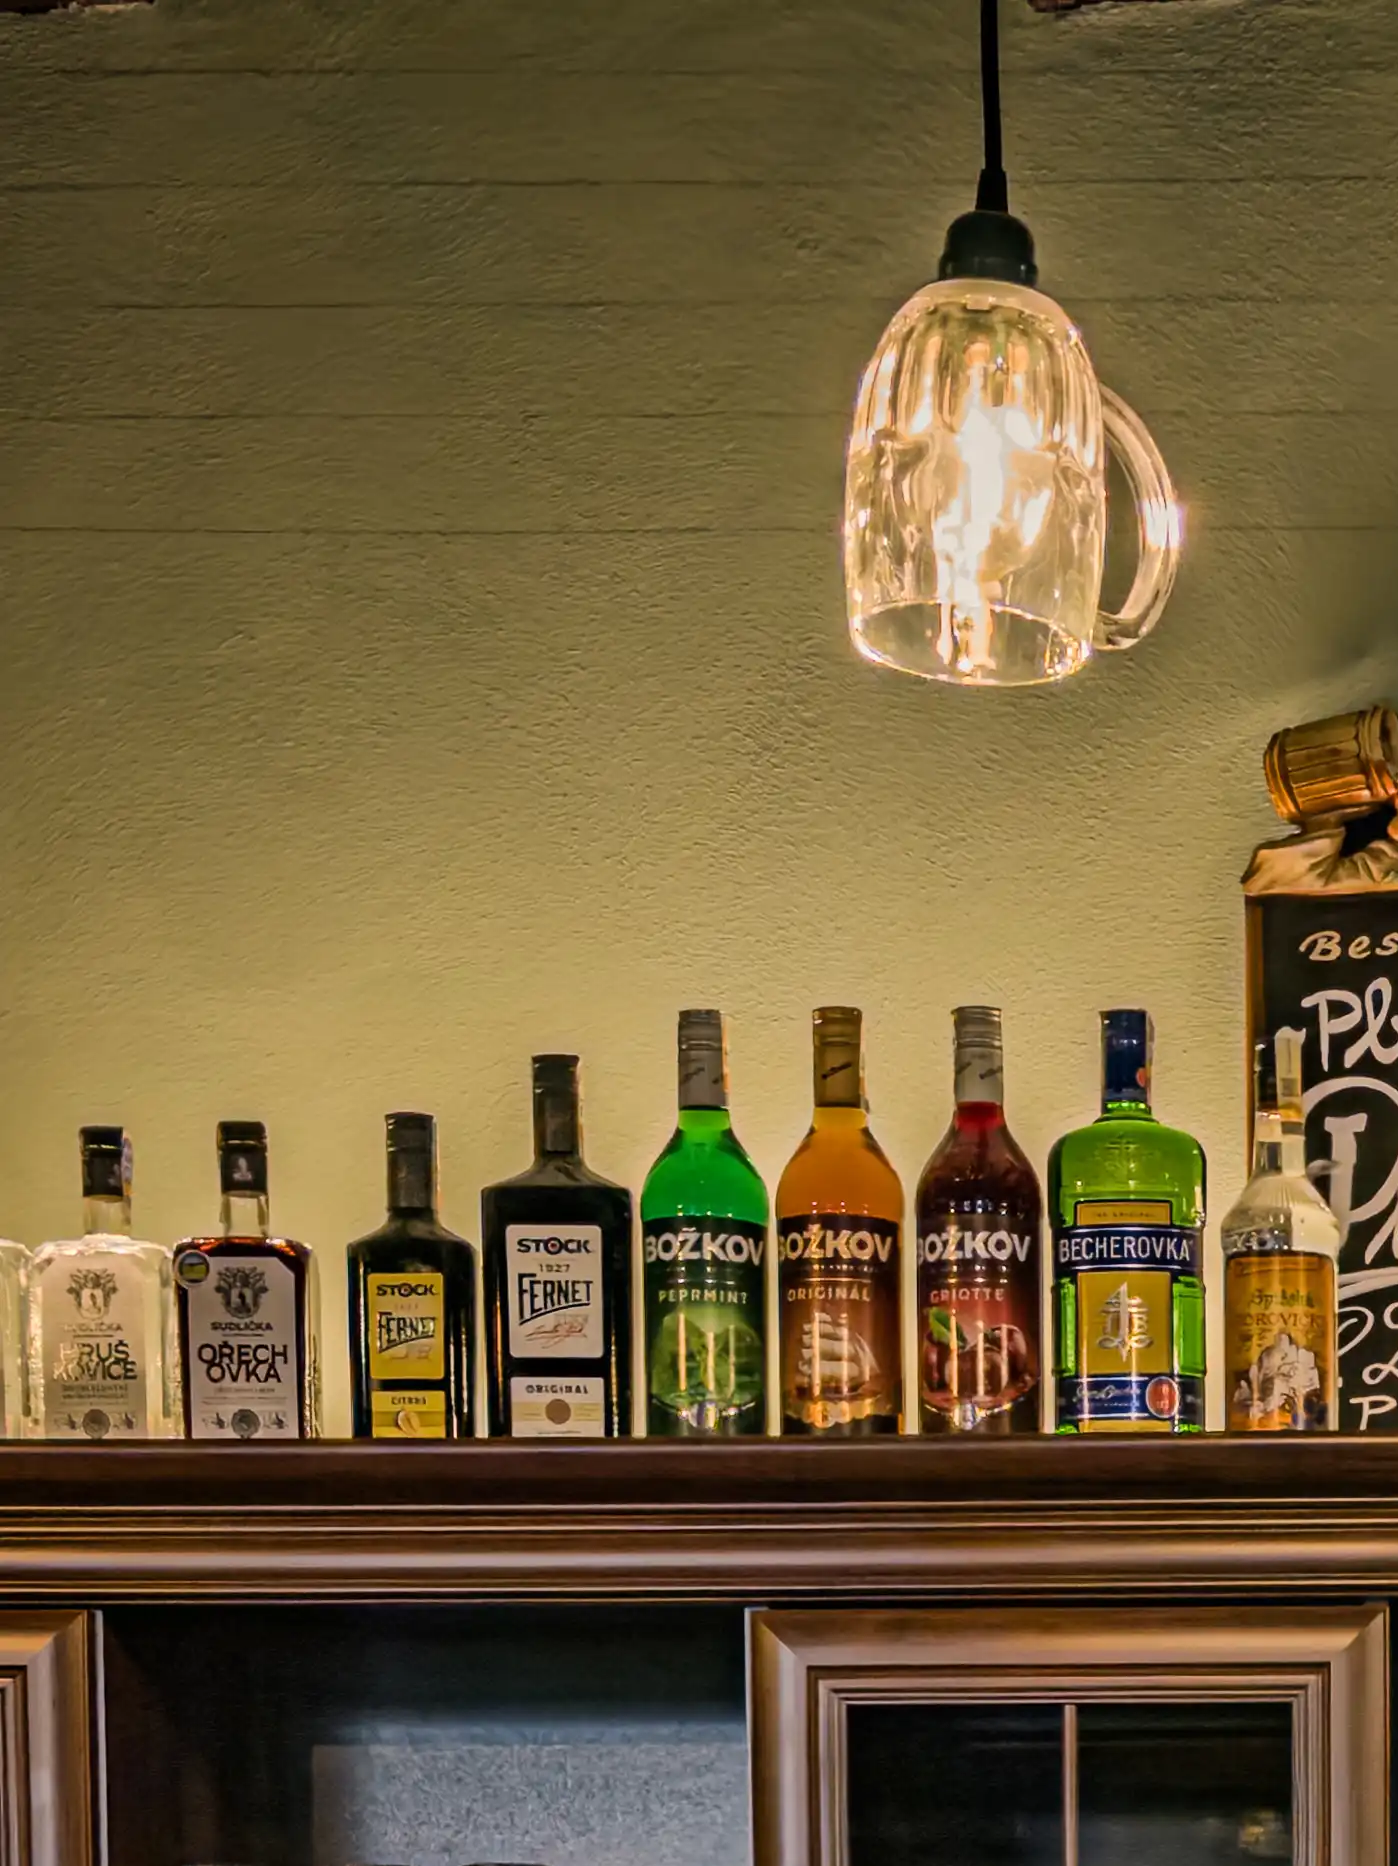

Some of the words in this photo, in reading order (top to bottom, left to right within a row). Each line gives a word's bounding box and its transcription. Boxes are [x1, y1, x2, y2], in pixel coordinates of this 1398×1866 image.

[516, 1237, 592, 1254] STOCK
[645, 1227, 764, 1266] BOŽKOV
[1059, 1236, 1190, 1263] BECHEROVKA
[376, 1283, 438, 1297] STOCK
[518, 1273, 593, 1319] FERNET
[930, 1287, 1005, 1303] GRIOTTE
[197, 1341, 288, 1364] OŘECH
[206, 1361, 282, 1383] OVKA
